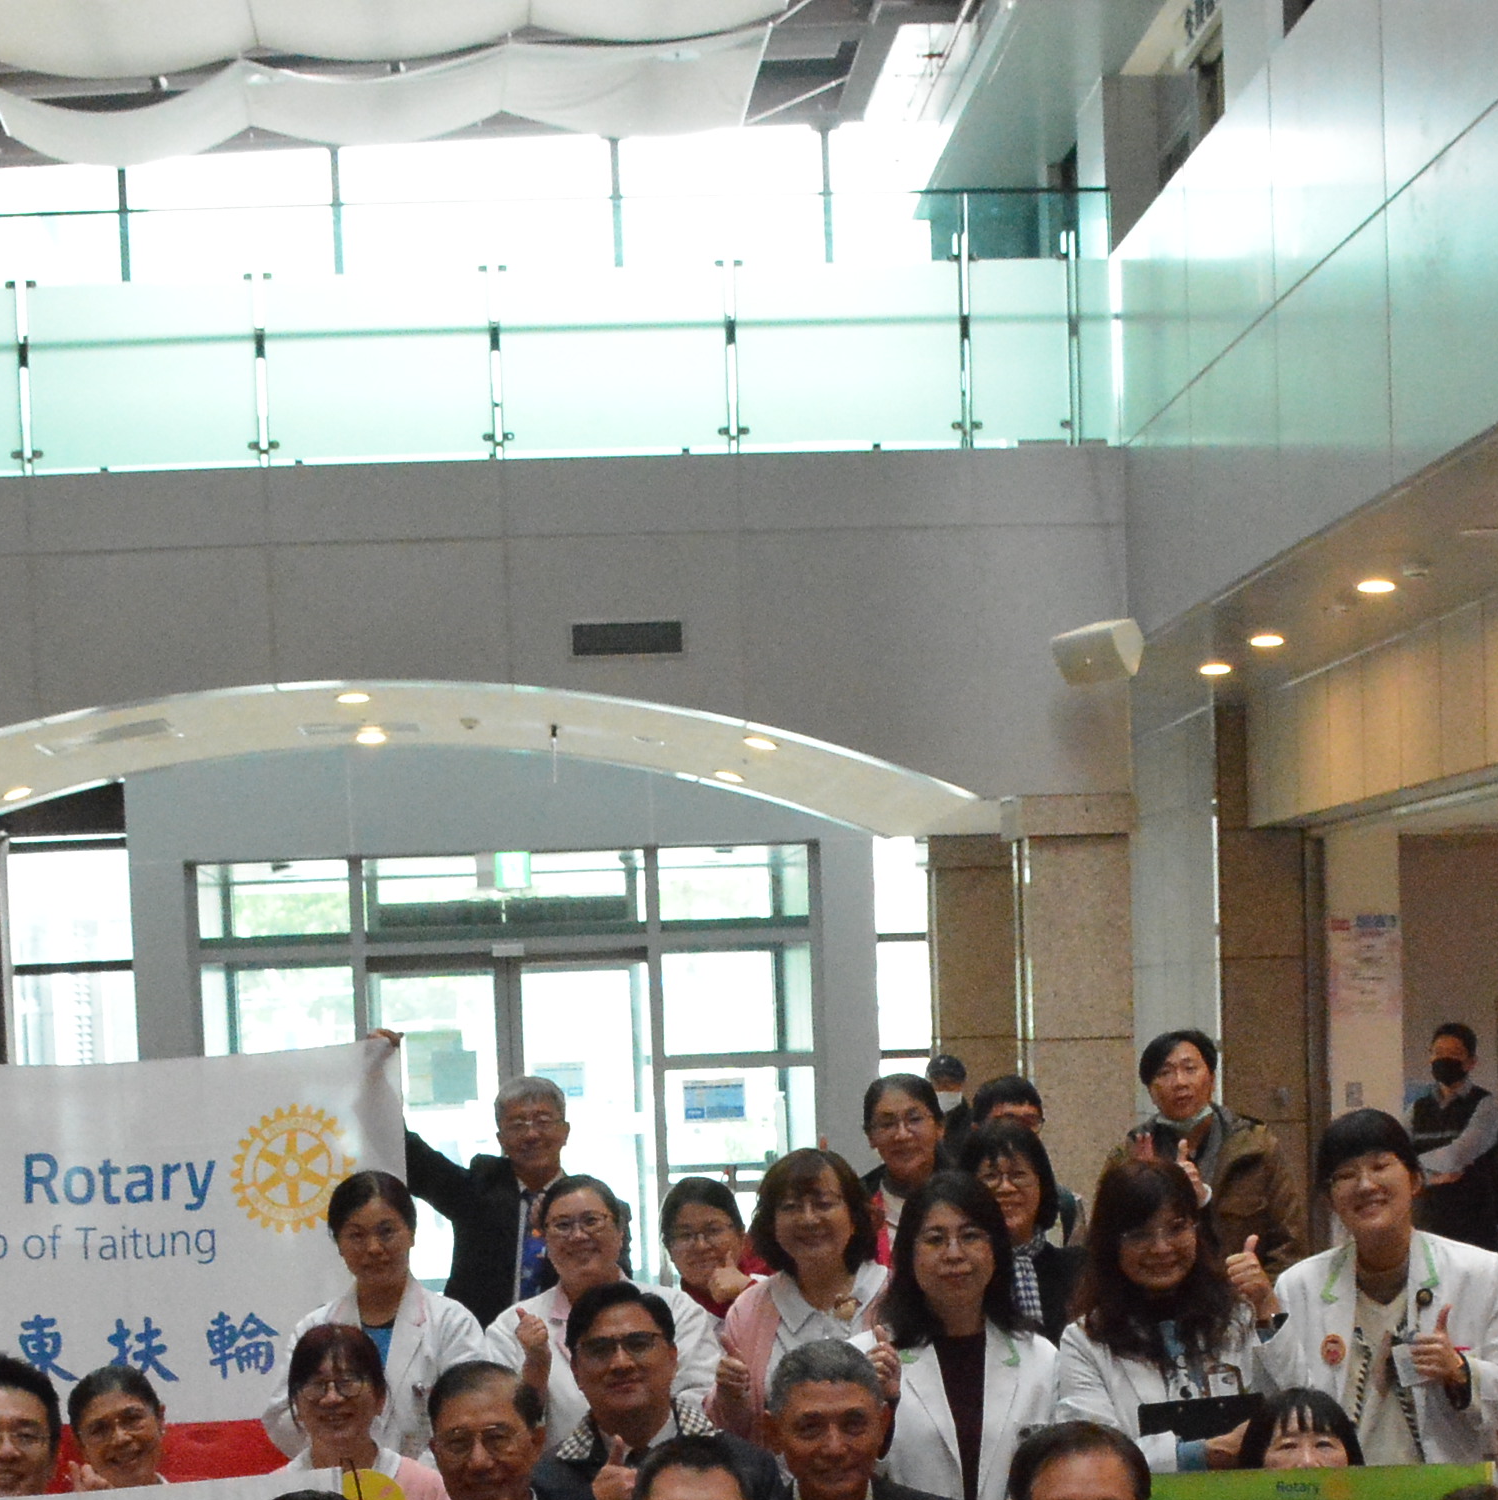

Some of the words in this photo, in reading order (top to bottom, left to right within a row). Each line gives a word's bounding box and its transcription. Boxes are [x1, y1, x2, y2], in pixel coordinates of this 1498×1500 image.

[23, 1152, 216, 1210] Rotary
[22, 1224, 62, 1260] of
[75, 1224, 216, 1264] Taitung
[18, 1311, 281, 1383] 東扶輪
[1276, 1480, 1321, 1495] Rotary
